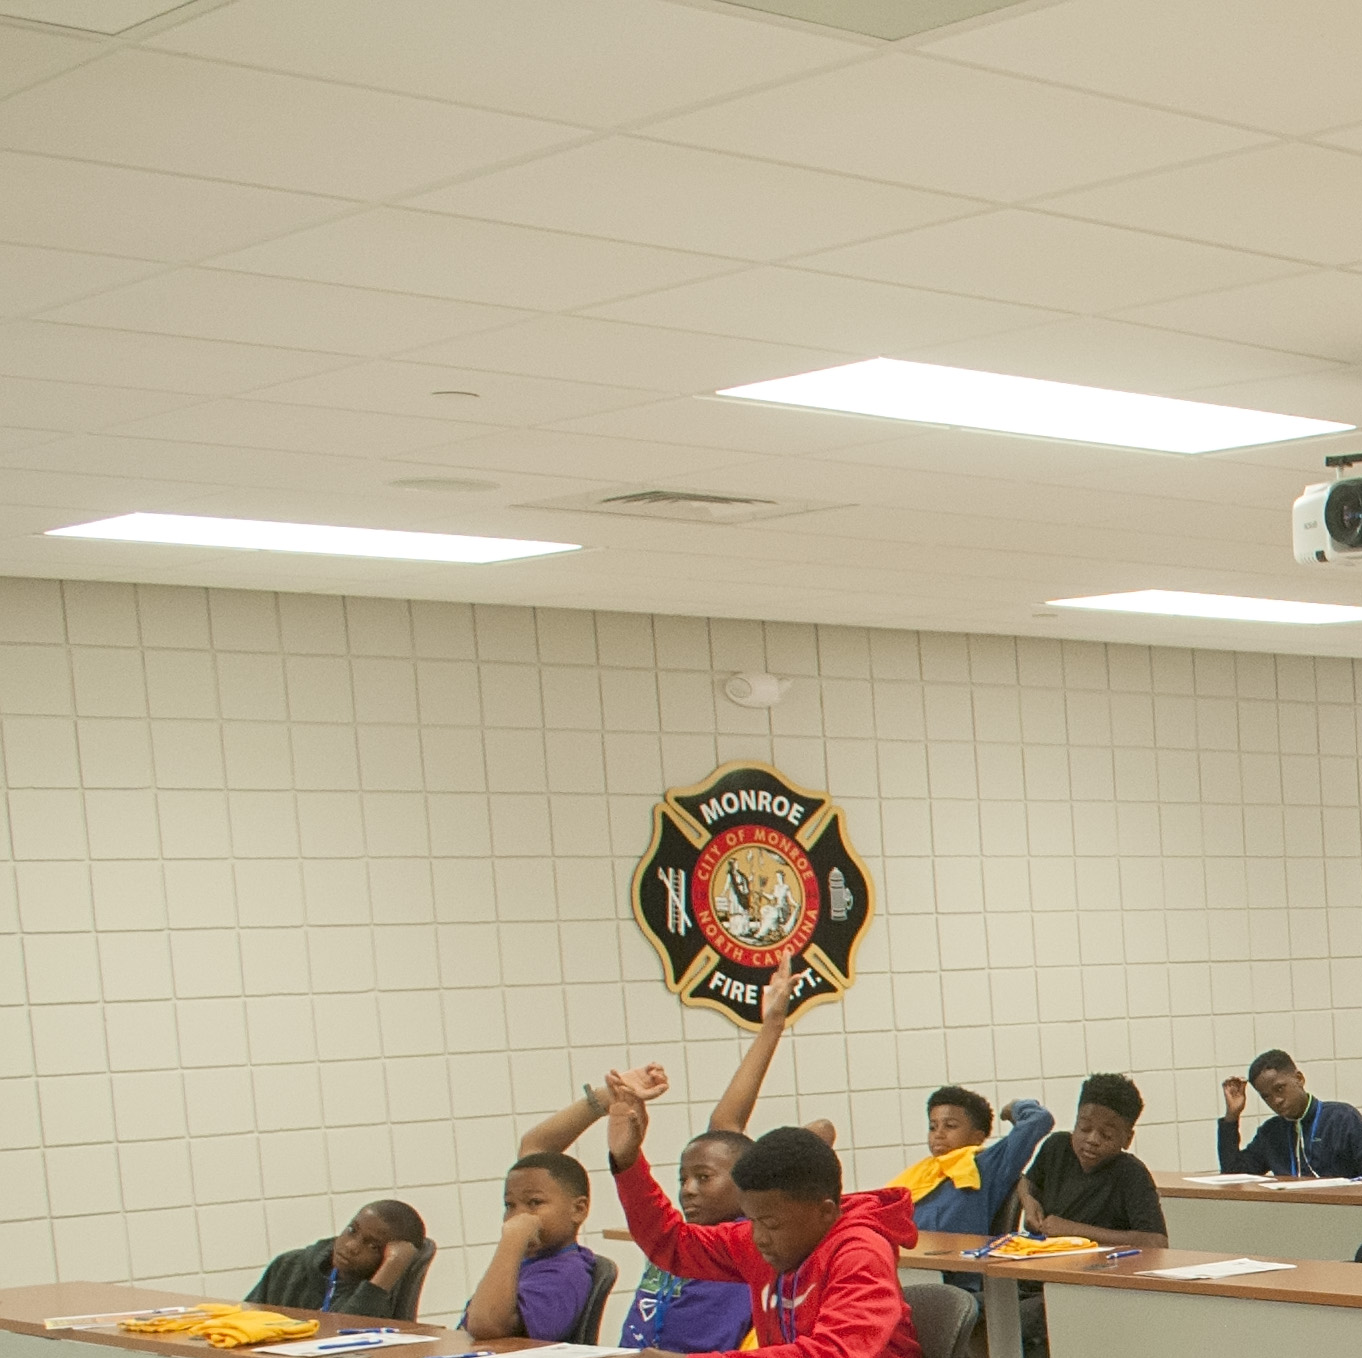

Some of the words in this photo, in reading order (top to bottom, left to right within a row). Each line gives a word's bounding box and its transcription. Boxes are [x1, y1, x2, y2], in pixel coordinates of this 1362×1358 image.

[700, 789, 805, 826] MONROE
[698, 844, 721, 880] CITY
[725, 829, 746, 846] OF
[754, 829, 814, 879] MONROE
[699, 910, 743, 961] NORTH
[752, 909, 818, 965] CAROLINA
[708, 970, 758, 1005] FIRE
[762, 967, 822, 1003] PT.
